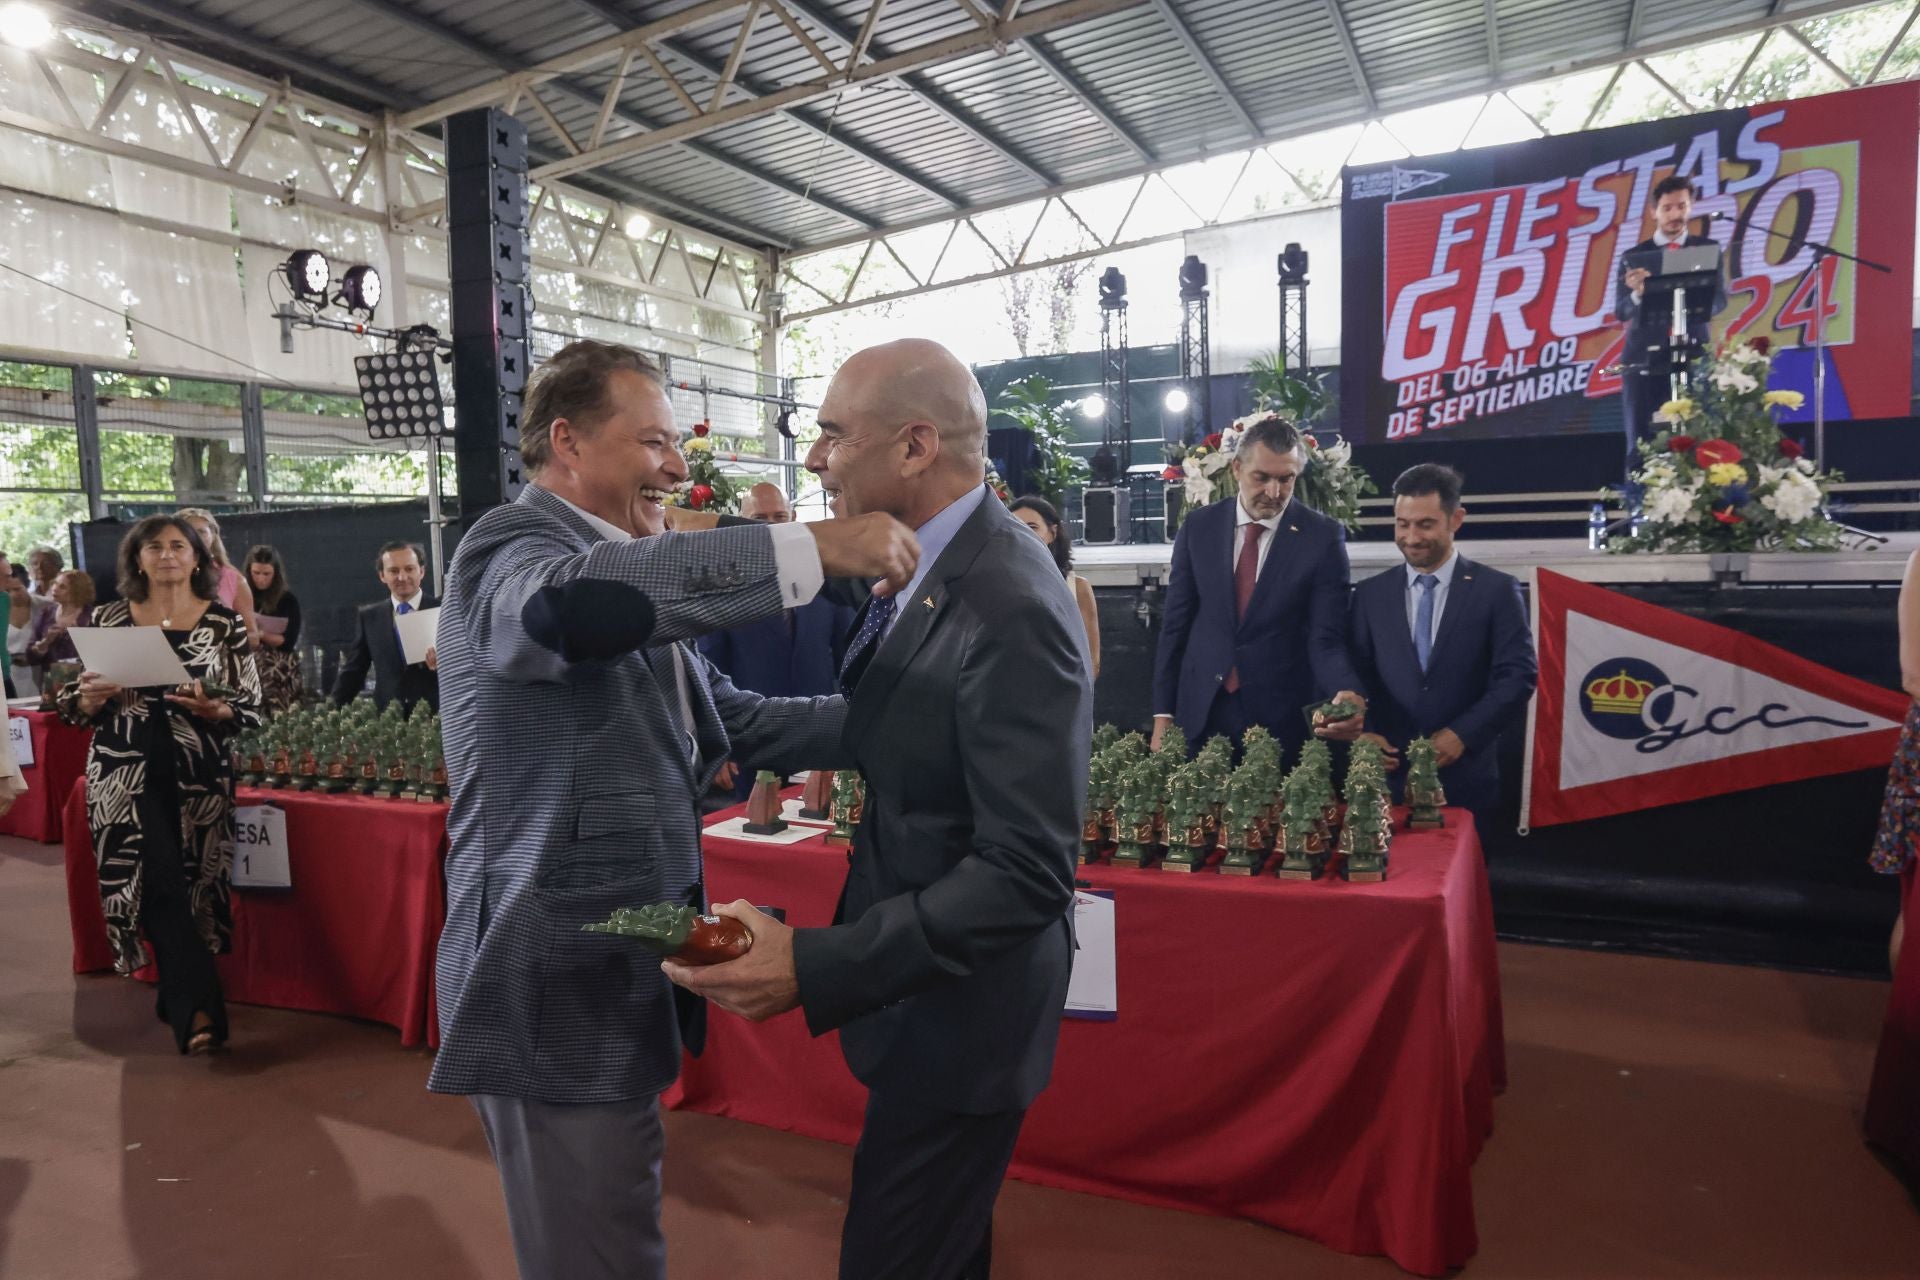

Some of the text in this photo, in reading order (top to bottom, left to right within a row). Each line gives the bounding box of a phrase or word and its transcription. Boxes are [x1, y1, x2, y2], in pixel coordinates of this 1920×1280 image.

[1431, 110, 1785, 277] FIESTAS
[1386, 363, 1589, 439] DE SEPTIEMBRE
[1396, 336, 1578, 408] DEL 06 AL 09
[235, 822, 271, 846] ESA
[242, 854, 250, 876] 1
